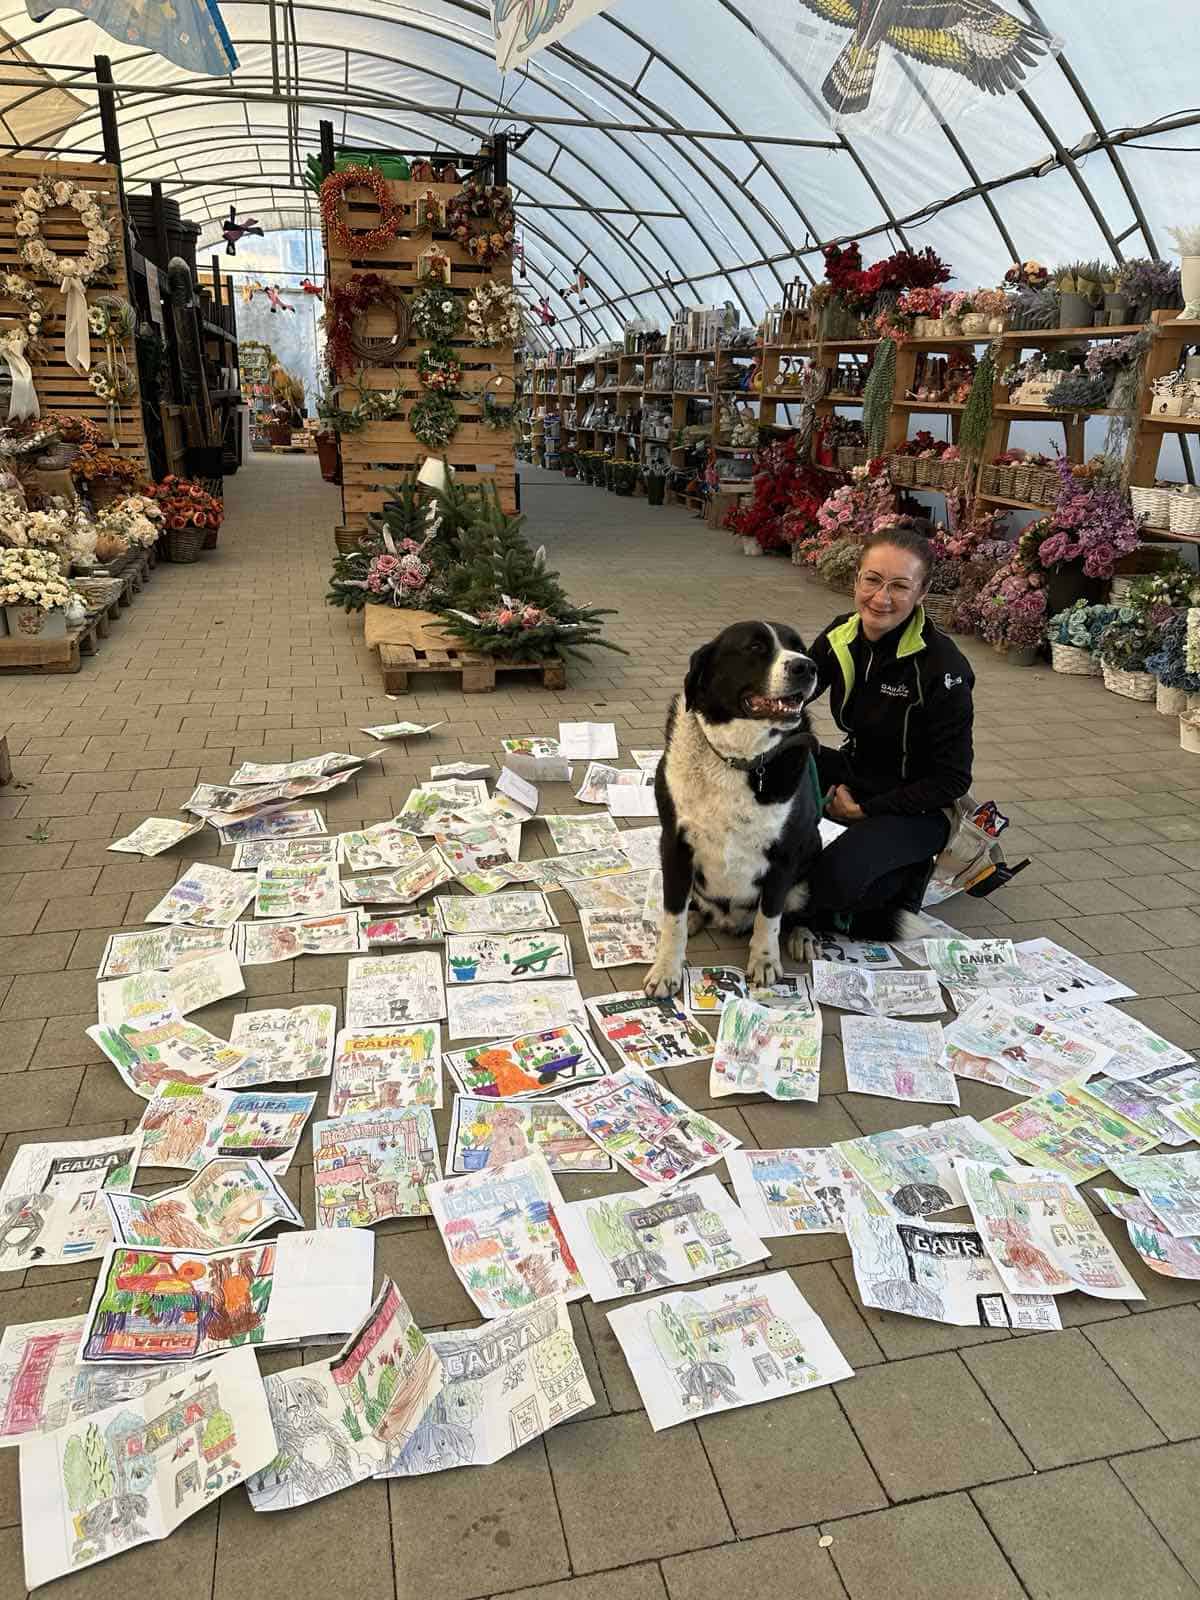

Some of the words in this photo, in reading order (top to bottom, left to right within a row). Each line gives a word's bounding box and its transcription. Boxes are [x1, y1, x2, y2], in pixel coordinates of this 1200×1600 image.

[961, 953, 1005, 965] GAURA
[353, 1039, 415, 1049] GAURA
[59, 1154, 119, 1172] GAURA
[448, 1323, 542, 1376] GAURA
